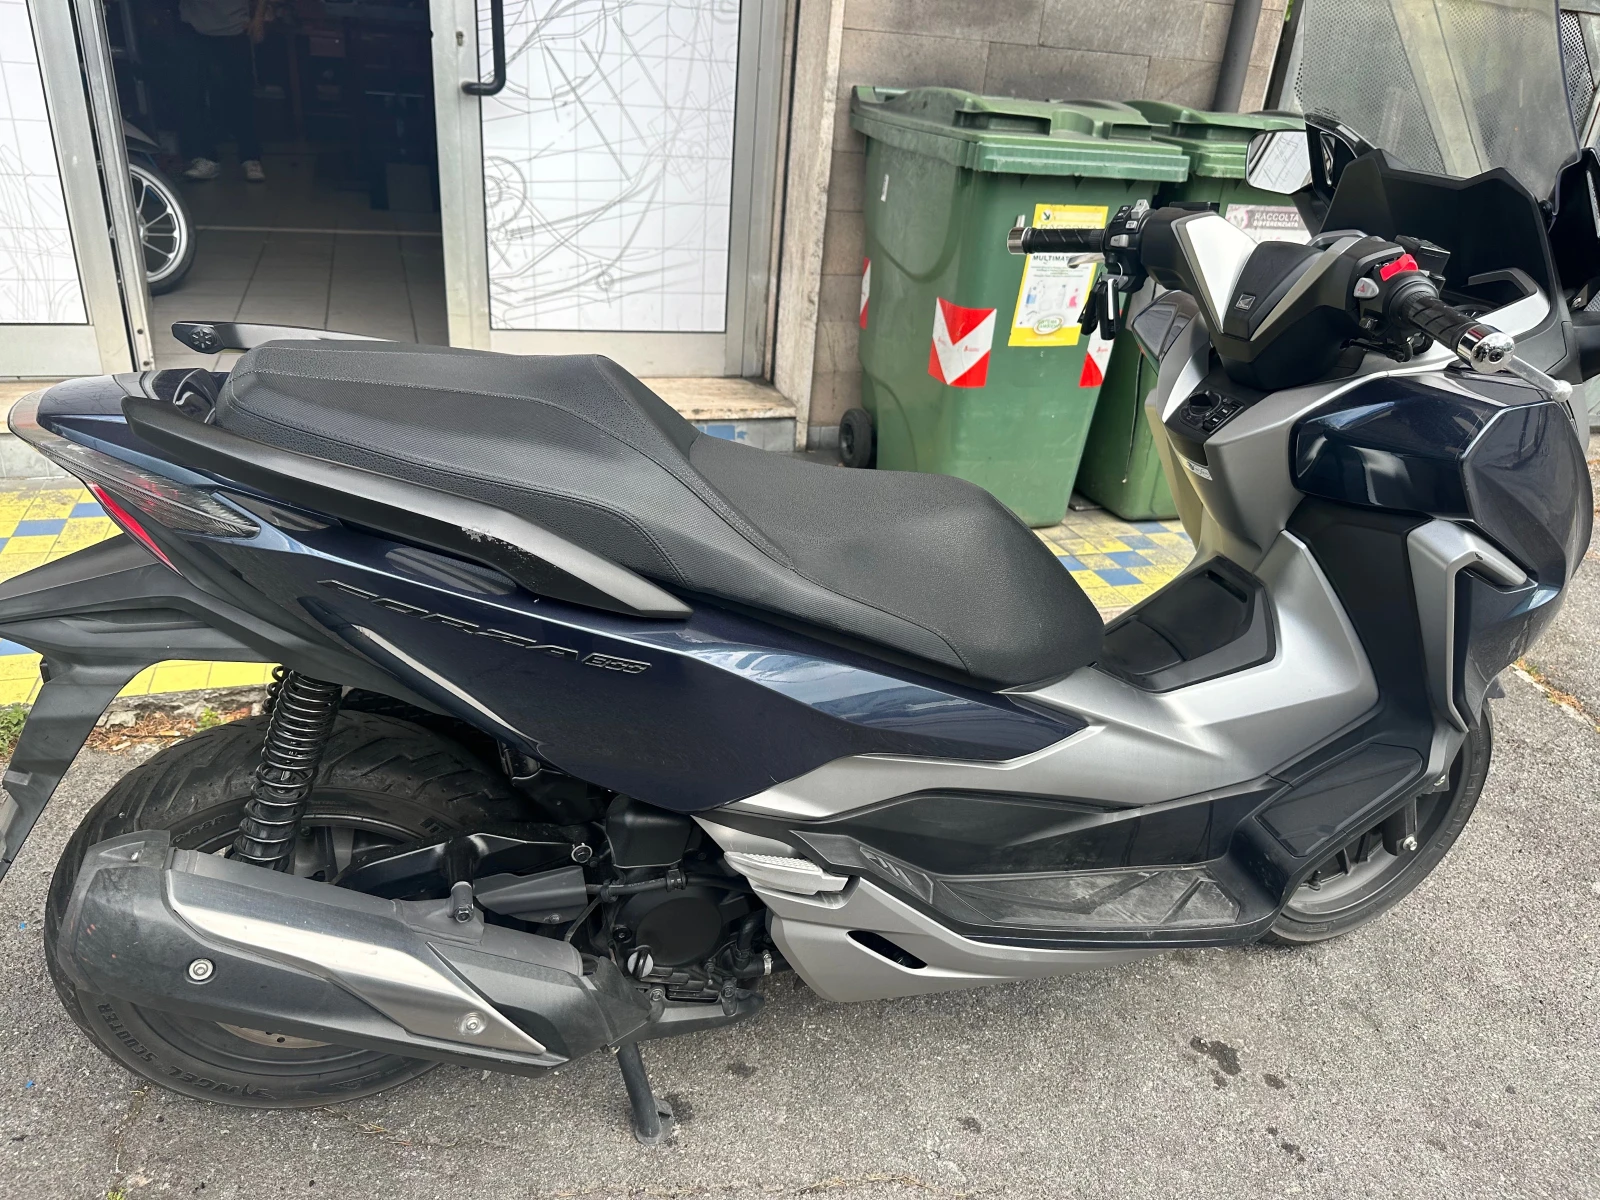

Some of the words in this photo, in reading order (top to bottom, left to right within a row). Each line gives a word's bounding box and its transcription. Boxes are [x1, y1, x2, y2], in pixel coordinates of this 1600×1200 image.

[1254, 212, 1299, 221] RACCOLTA
[316, 579, 579, 661] FORZA
[97, 1003, 160, 1063] SCOOTER
